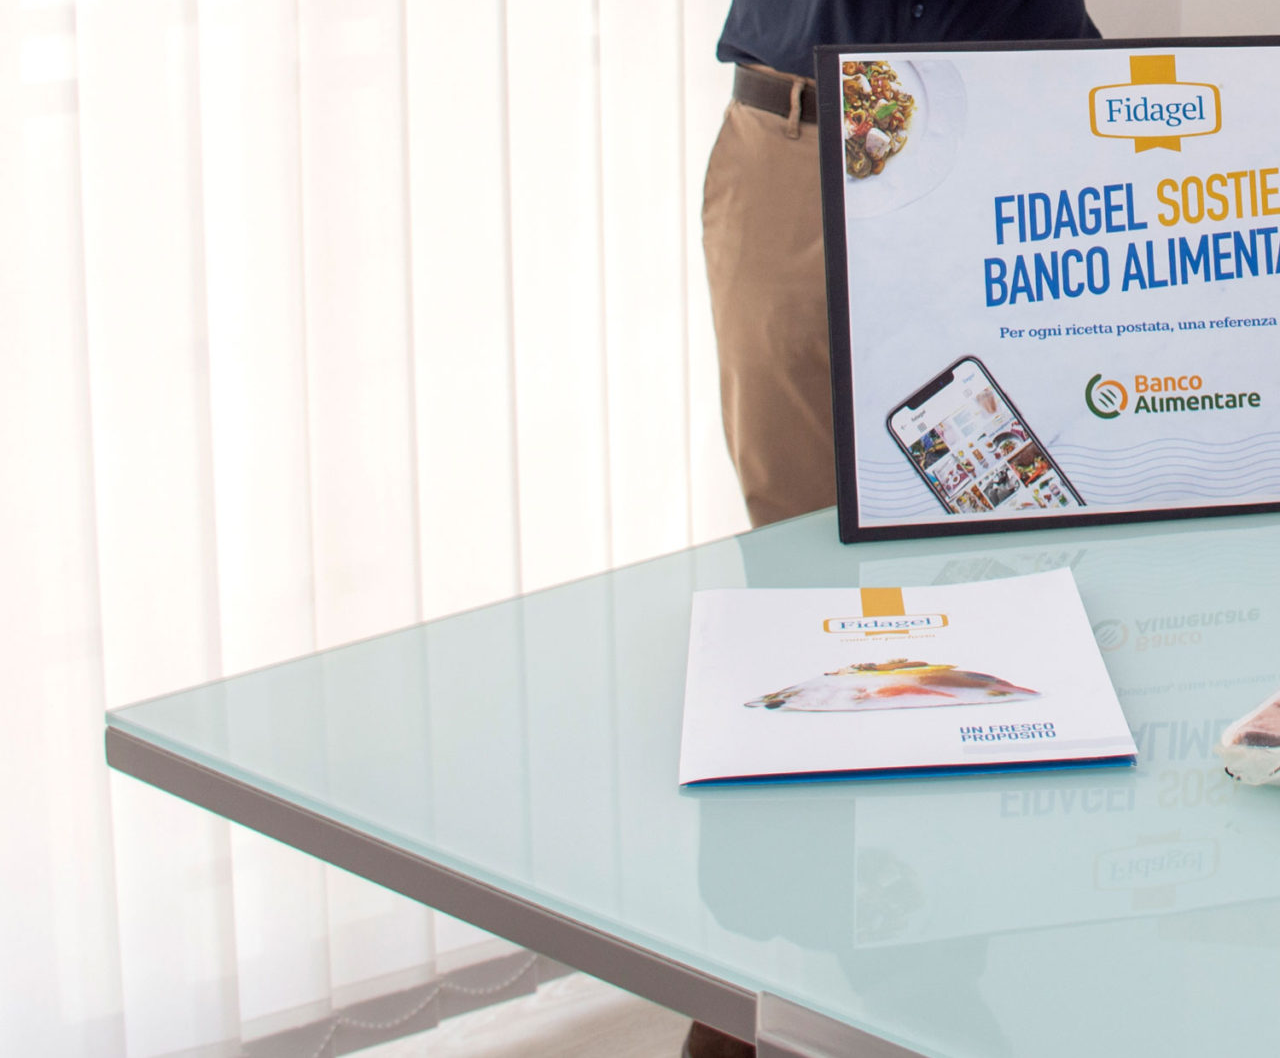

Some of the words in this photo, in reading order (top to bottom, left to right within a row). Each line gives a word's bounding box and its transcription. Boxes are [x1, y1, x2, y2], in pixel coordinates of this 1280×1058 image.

[1105, 95, 1206, 127] Fidagel
[994, 182, 1148, 245] FIDAGEL
[984, 246, 1111, 307] BANCO
[1000, 327, 1025, 339] Per
[1028, 325, 1062, 340] ogni
[1065, 323, 1113, 336] ricetta
[1116, 321, 1175, 336] postata,
[1178, 319, 1206, 331] una
[1209, 315, 1278, 330] referenza
[1134, 374, 1203, 393] Banco
[1134, 392, 1261, 414] Alimentare
[839, 617, 931, 630] Fidagel
[960, 725, 984, 734] UN
[988, 722, 1055, 733] FRESCO
[961, 730, 1057, 742] PROPOSITO
